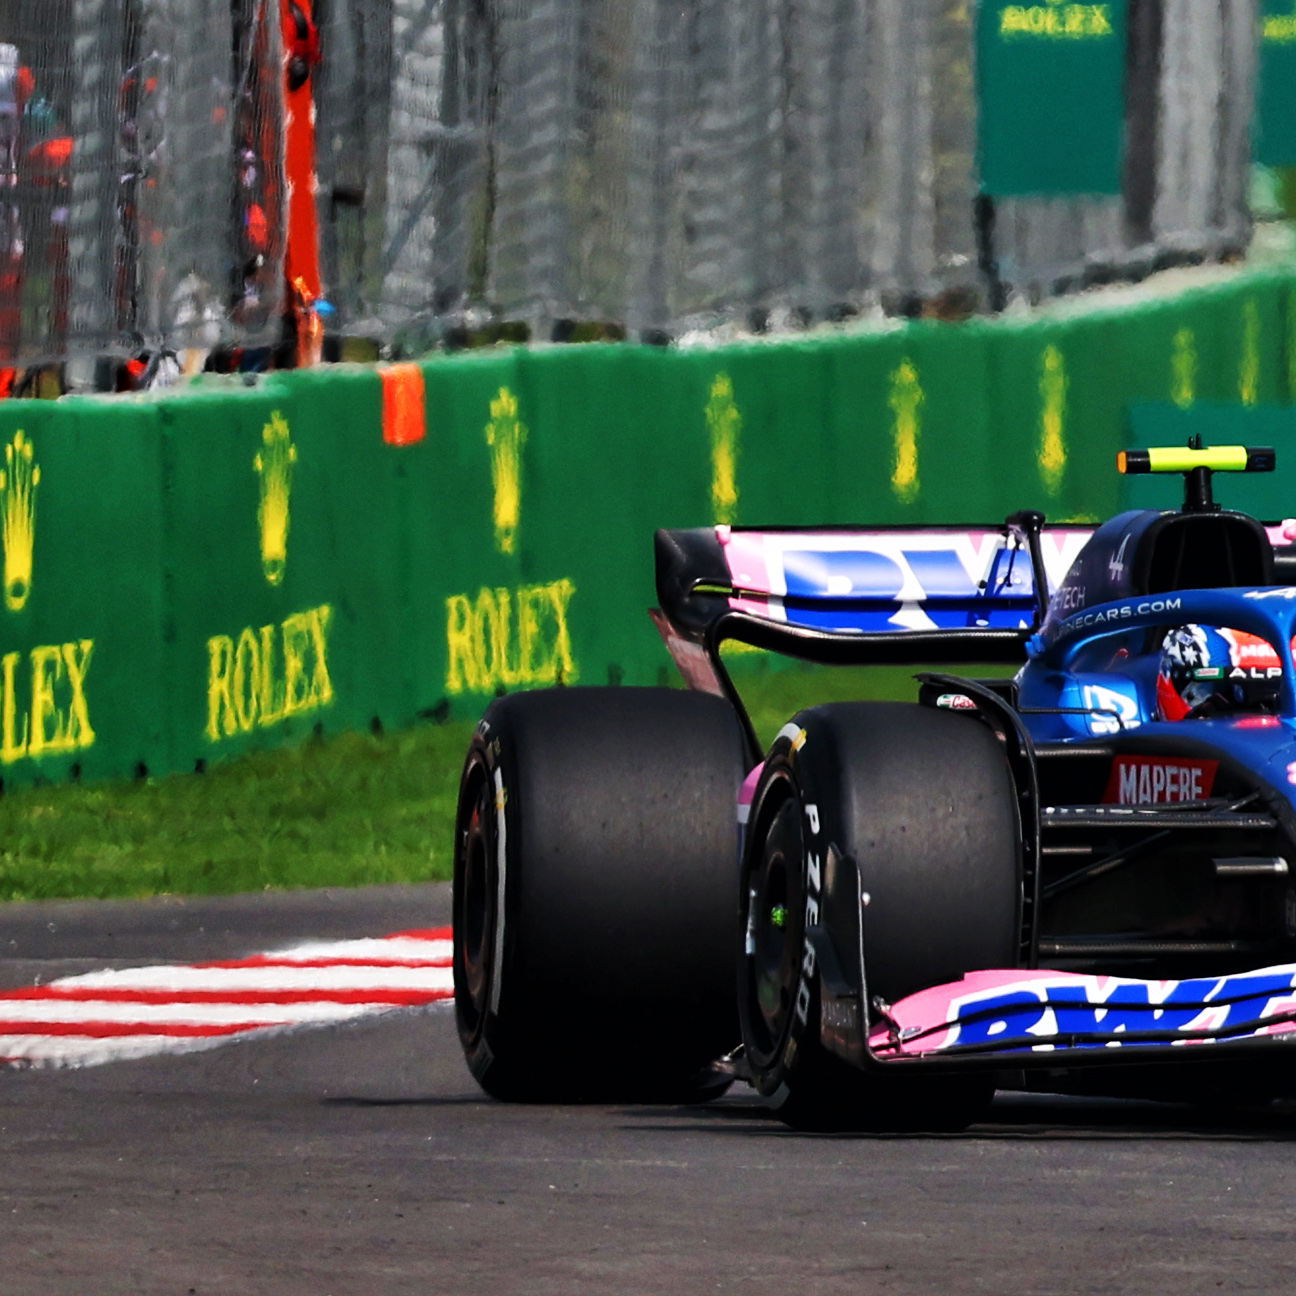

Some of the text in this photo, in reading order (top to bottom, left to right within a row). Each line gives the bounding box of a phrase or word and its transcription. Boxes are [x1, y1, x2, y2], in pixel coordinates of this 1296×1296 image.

[206, 605, 334, 741] ROLEX
[445, 578, 577, 693] ROLEX
[0, 638, 96, 763] LEX
[1119, 763, 1203, 805] MAPFRE
